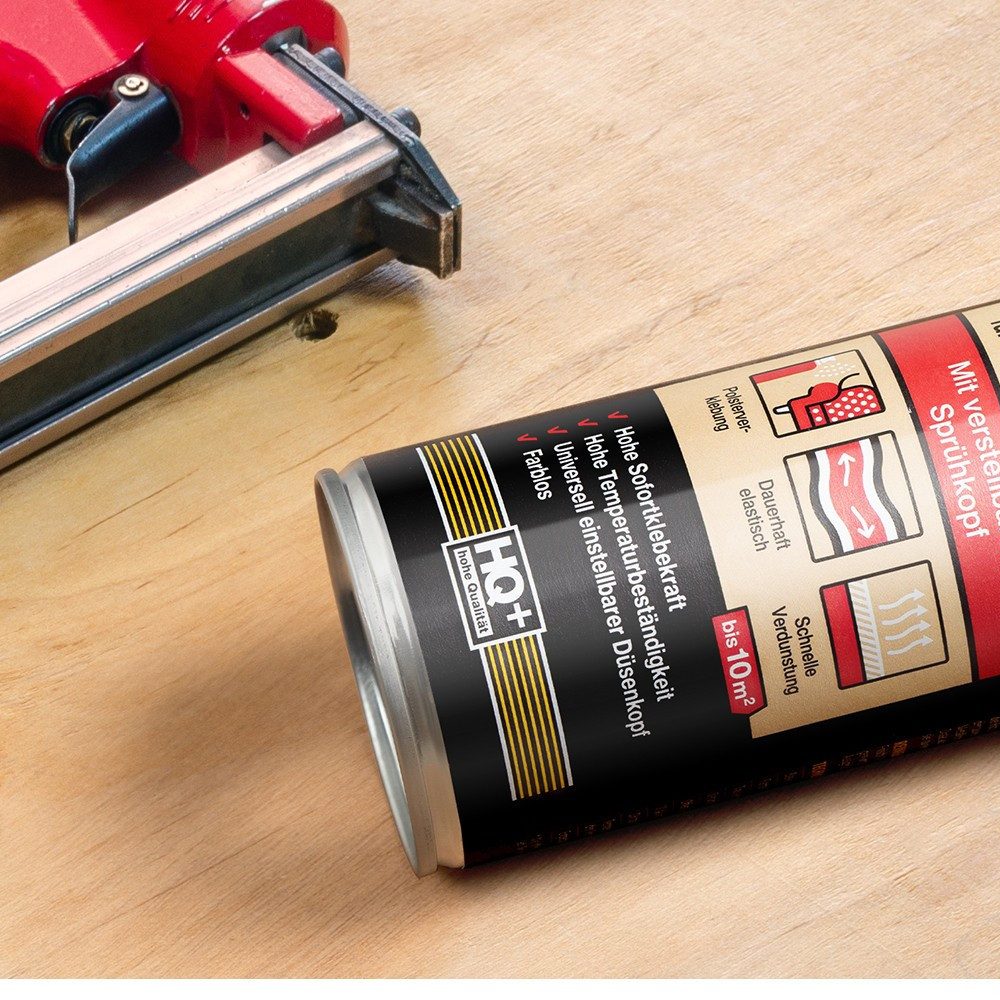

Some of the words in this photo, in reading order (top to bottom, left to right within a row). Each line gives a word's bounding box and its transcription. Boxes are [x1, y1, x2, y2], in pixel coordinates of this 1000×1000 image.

[723, 385, 751, 433] Polsterver-
[948, 360, 979, 395] Mit
[705, 395, 729, 432] klebung
[523, 448, 552, 500] Farblos
[929, 403, 990, 538] Sprühkopf
[614, 425, 640, 461] Hohe
[628, 463, 687, 612] Sofortklebekraft
[739, 488, 768, 551] elastisch
[758, 479, 791, 550] Dauerhaft
[457, 549, 472, 581] hohe
[467, 582, 488, 634] Qualität
[474, 535, 532, 628] HQ+
[553, 441, 595, 513] Universell
[578, 516, 625, 634] einstellbarer
[612, 638, 651, 738] Düsenkopf
[584, 433, 609, 469] Hohe
[598, 469, 675, 702] Temperaturbeständigkeit
[721, 620, 739, 648] bis
[772, 605, 799, 695] Verdunstung
[795, 616, 819, 677] Schnelle
